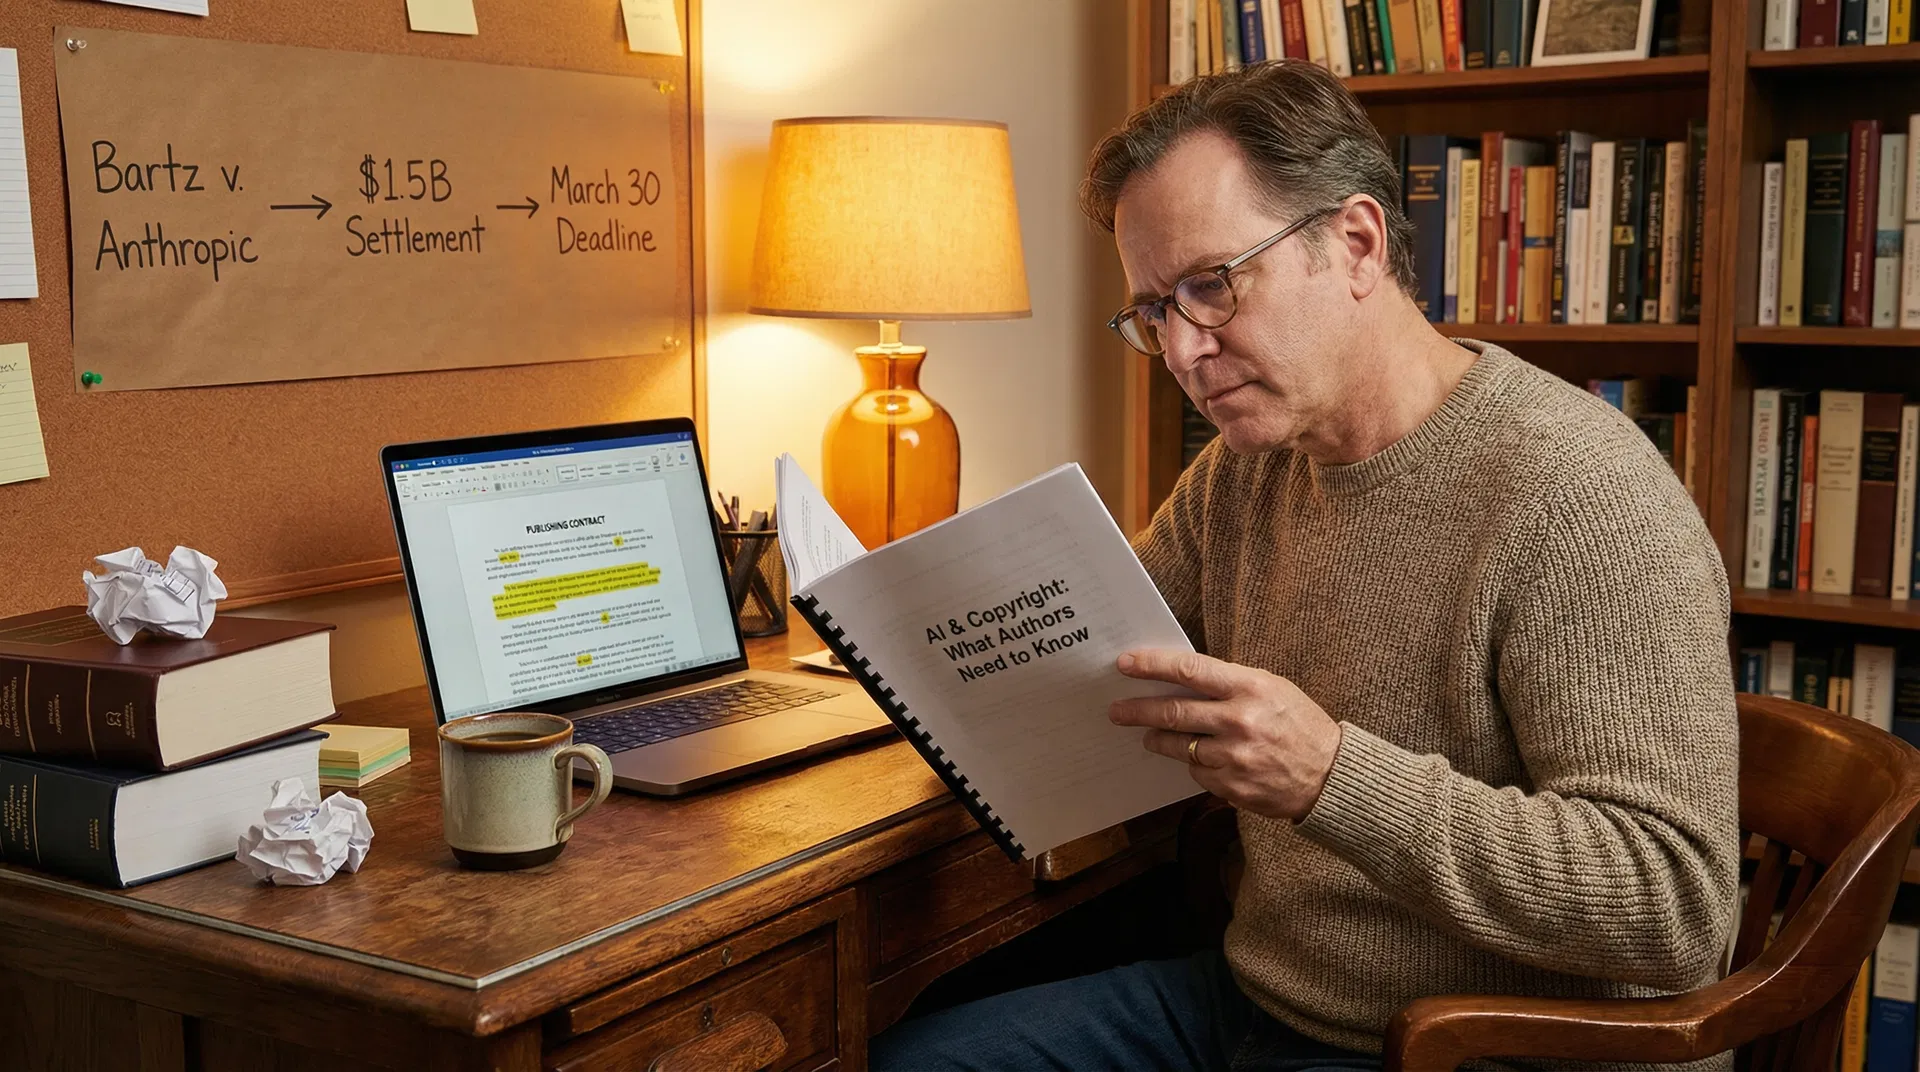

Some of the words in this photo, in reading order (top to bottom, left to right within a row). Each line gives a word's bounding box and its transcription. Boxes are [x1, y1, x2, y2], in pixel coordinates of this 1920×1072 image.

[92, 141, 204, 193] Bartz
[221, 165, 243, 192] v.
[359, 154, 451, 204] $1.5B
[551, 165, 619, 205] March
[628, 169, 660, 206] 30
[96, 220, 258, 282] Anthropic
[346, 215, 485, 256] Settlement
[557, 217, 658, 255] Deadline
[926, 625, 946, 644] AI
[948, 619, 966, 635] &
[967, 580, 1069, 627] Copyright:
[943, 634, 996, 661] What
[999, 606, 1075, 644] Authors
[957, 654, 1008, 682] Need
[1009, 651, 1030, 665] to
[1032, 627, 1088, 657] Know
